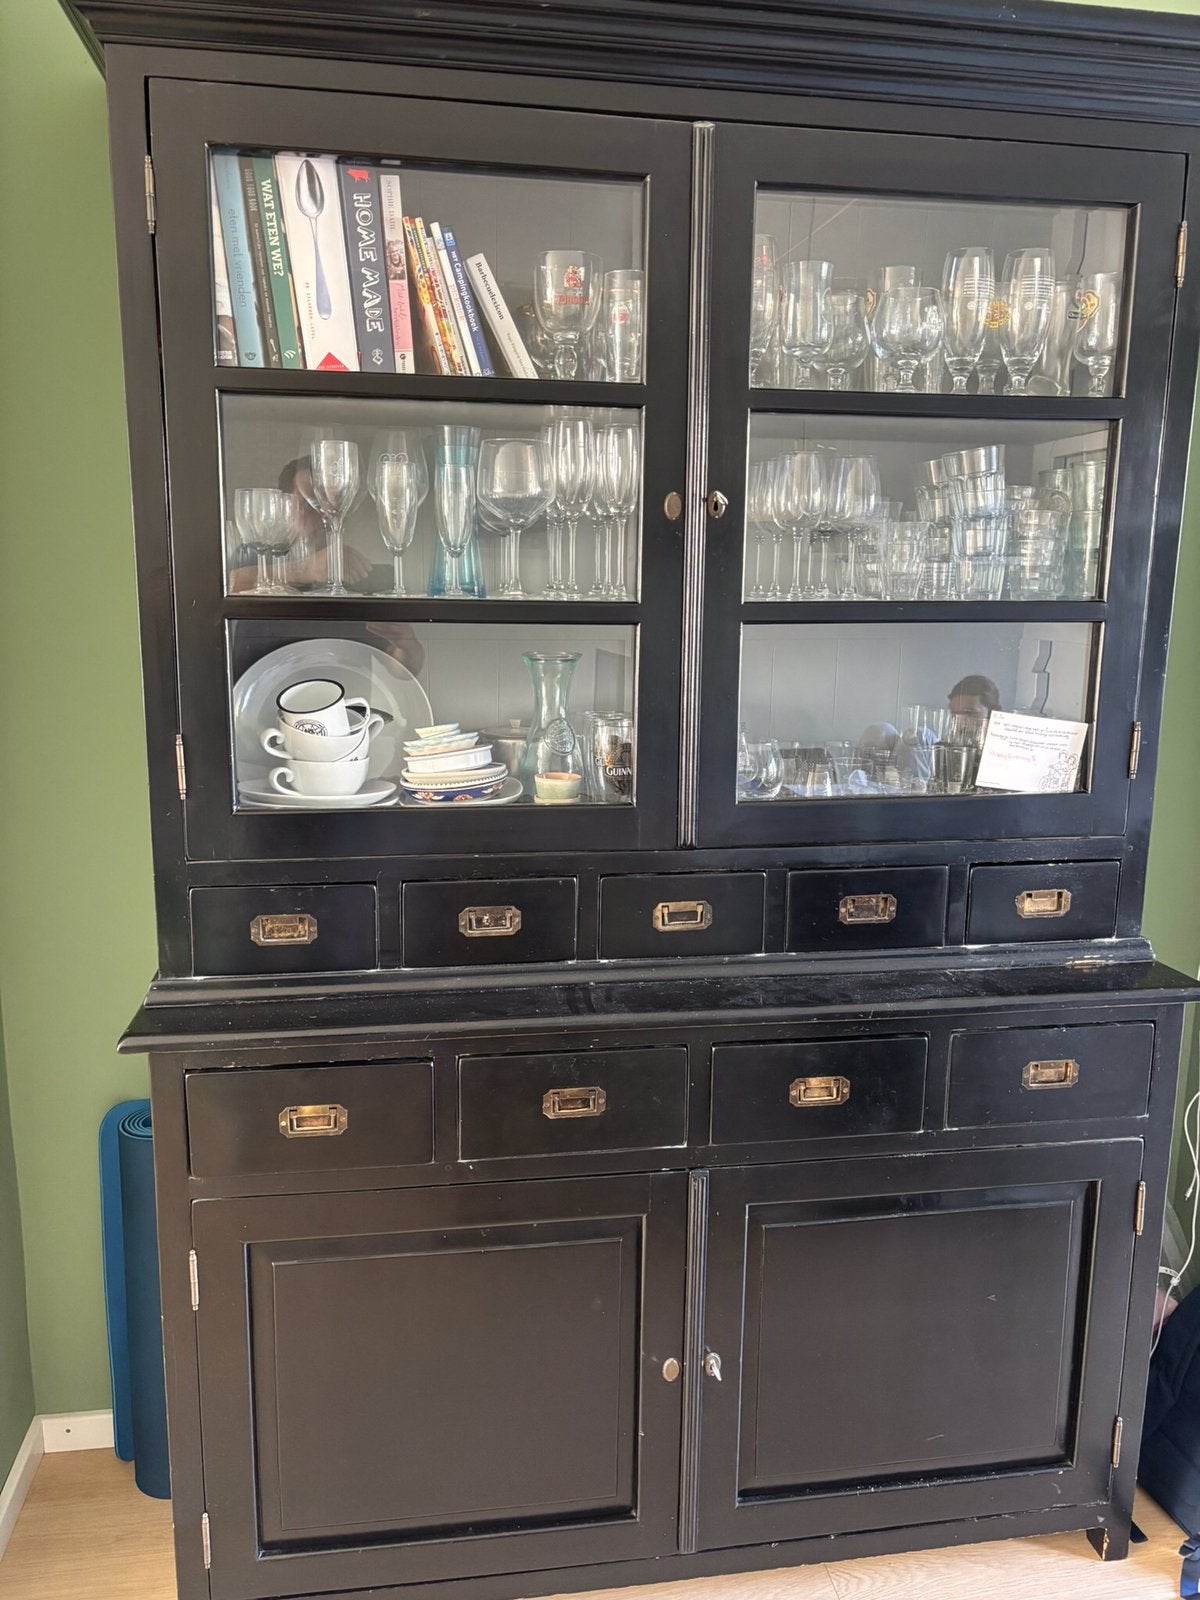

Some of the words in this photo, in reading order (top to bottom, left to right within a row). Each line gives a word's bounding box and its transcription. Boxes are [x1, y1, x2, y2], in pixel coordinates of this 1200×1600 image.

[261, 178, 275, 210] WAT
[228, 208, 239, 233] eten
[265, 211, 280, 247] ETEN
[353, 192, 378, 262] HOME
[232, 236, 244, 257] met
[271, 247, 285, 277] WE?
[235, 260, 252, 308] vrienden
[361, 267, 385, 332] MADE
[449, 283, 465, 321] picknick
[454, 262, 480, 332] Campingkookboek
[475, 261, 504, 320] Barbecuelexicon
[606, 766, 632, 776] GUINN
